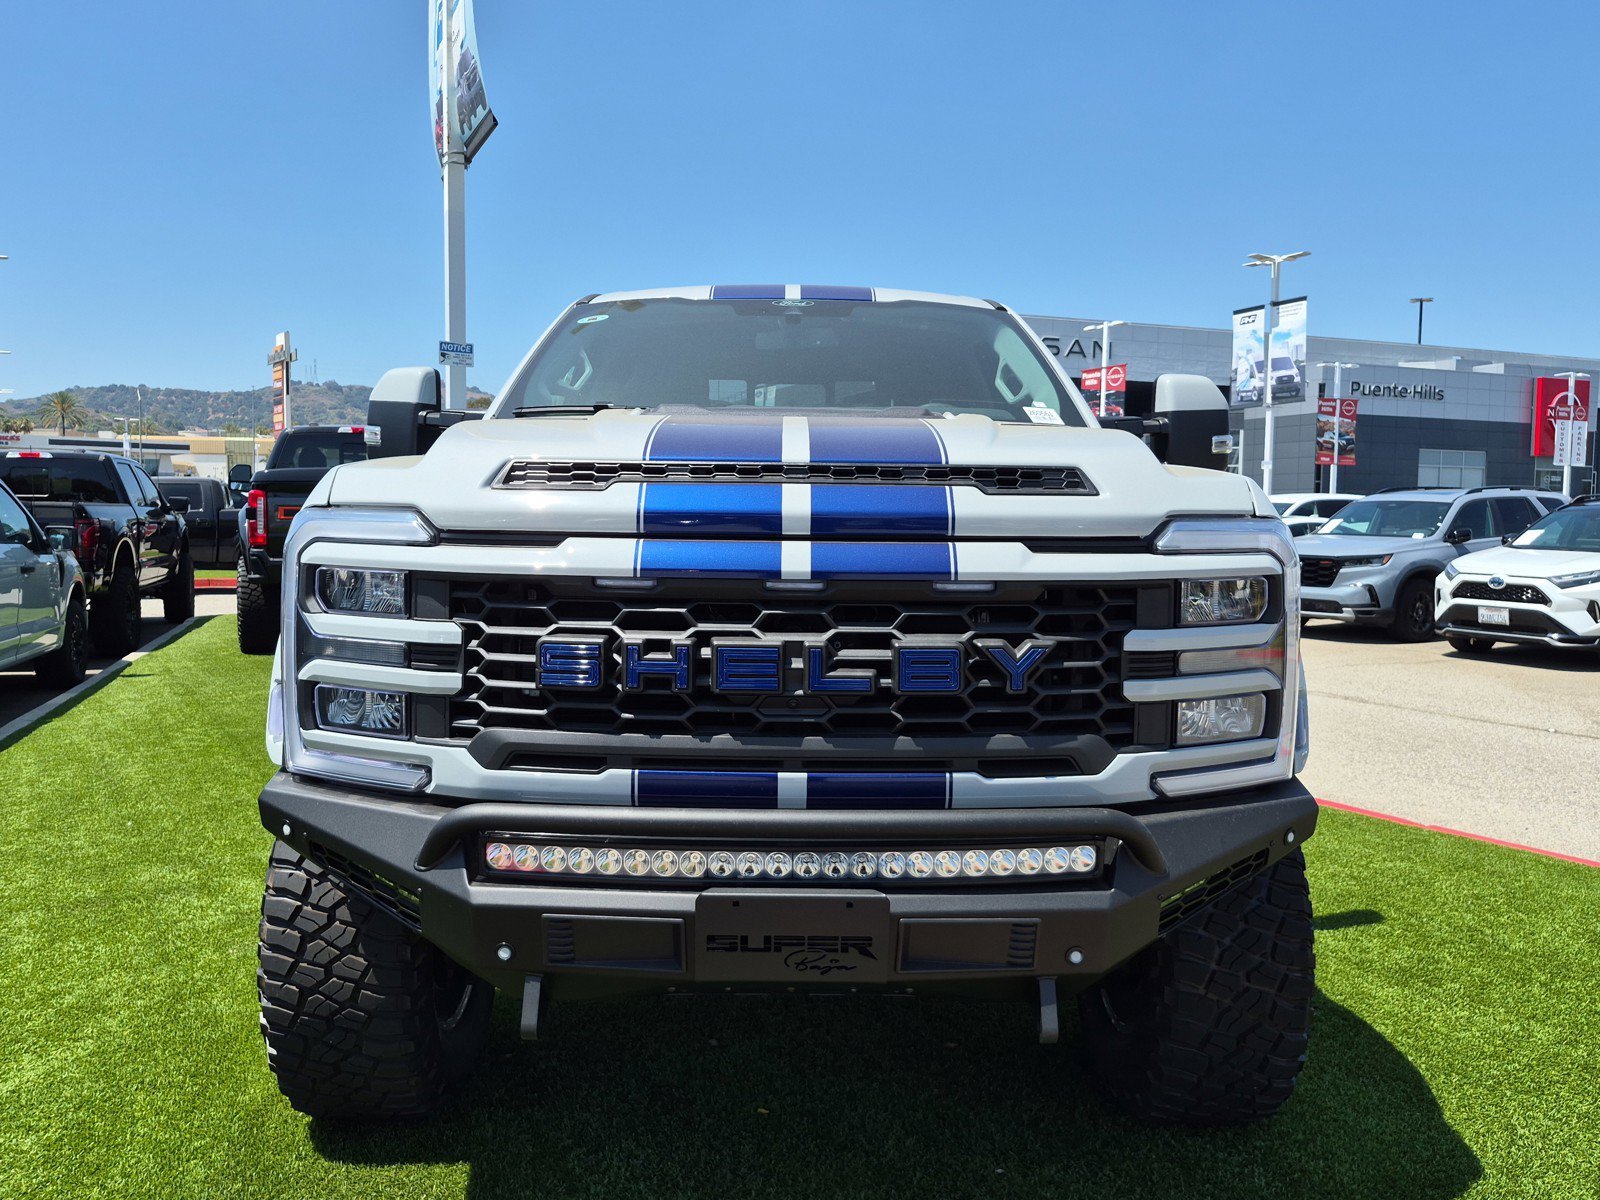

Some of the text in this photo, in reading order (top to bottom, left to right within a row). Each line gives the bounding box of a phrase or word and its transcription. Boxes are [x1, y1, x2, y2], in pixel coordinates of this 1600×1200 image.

[441, 343, 472, 352] NOTICE
[1082, 371, 1101, 379] Puente
[1351, 381, 1444, 400] Puente Hills
[536, 635, 1055, 697] SHELBY
[706, 935, 878, 960] SUPER
[784, 949, 857, 975] Baja
